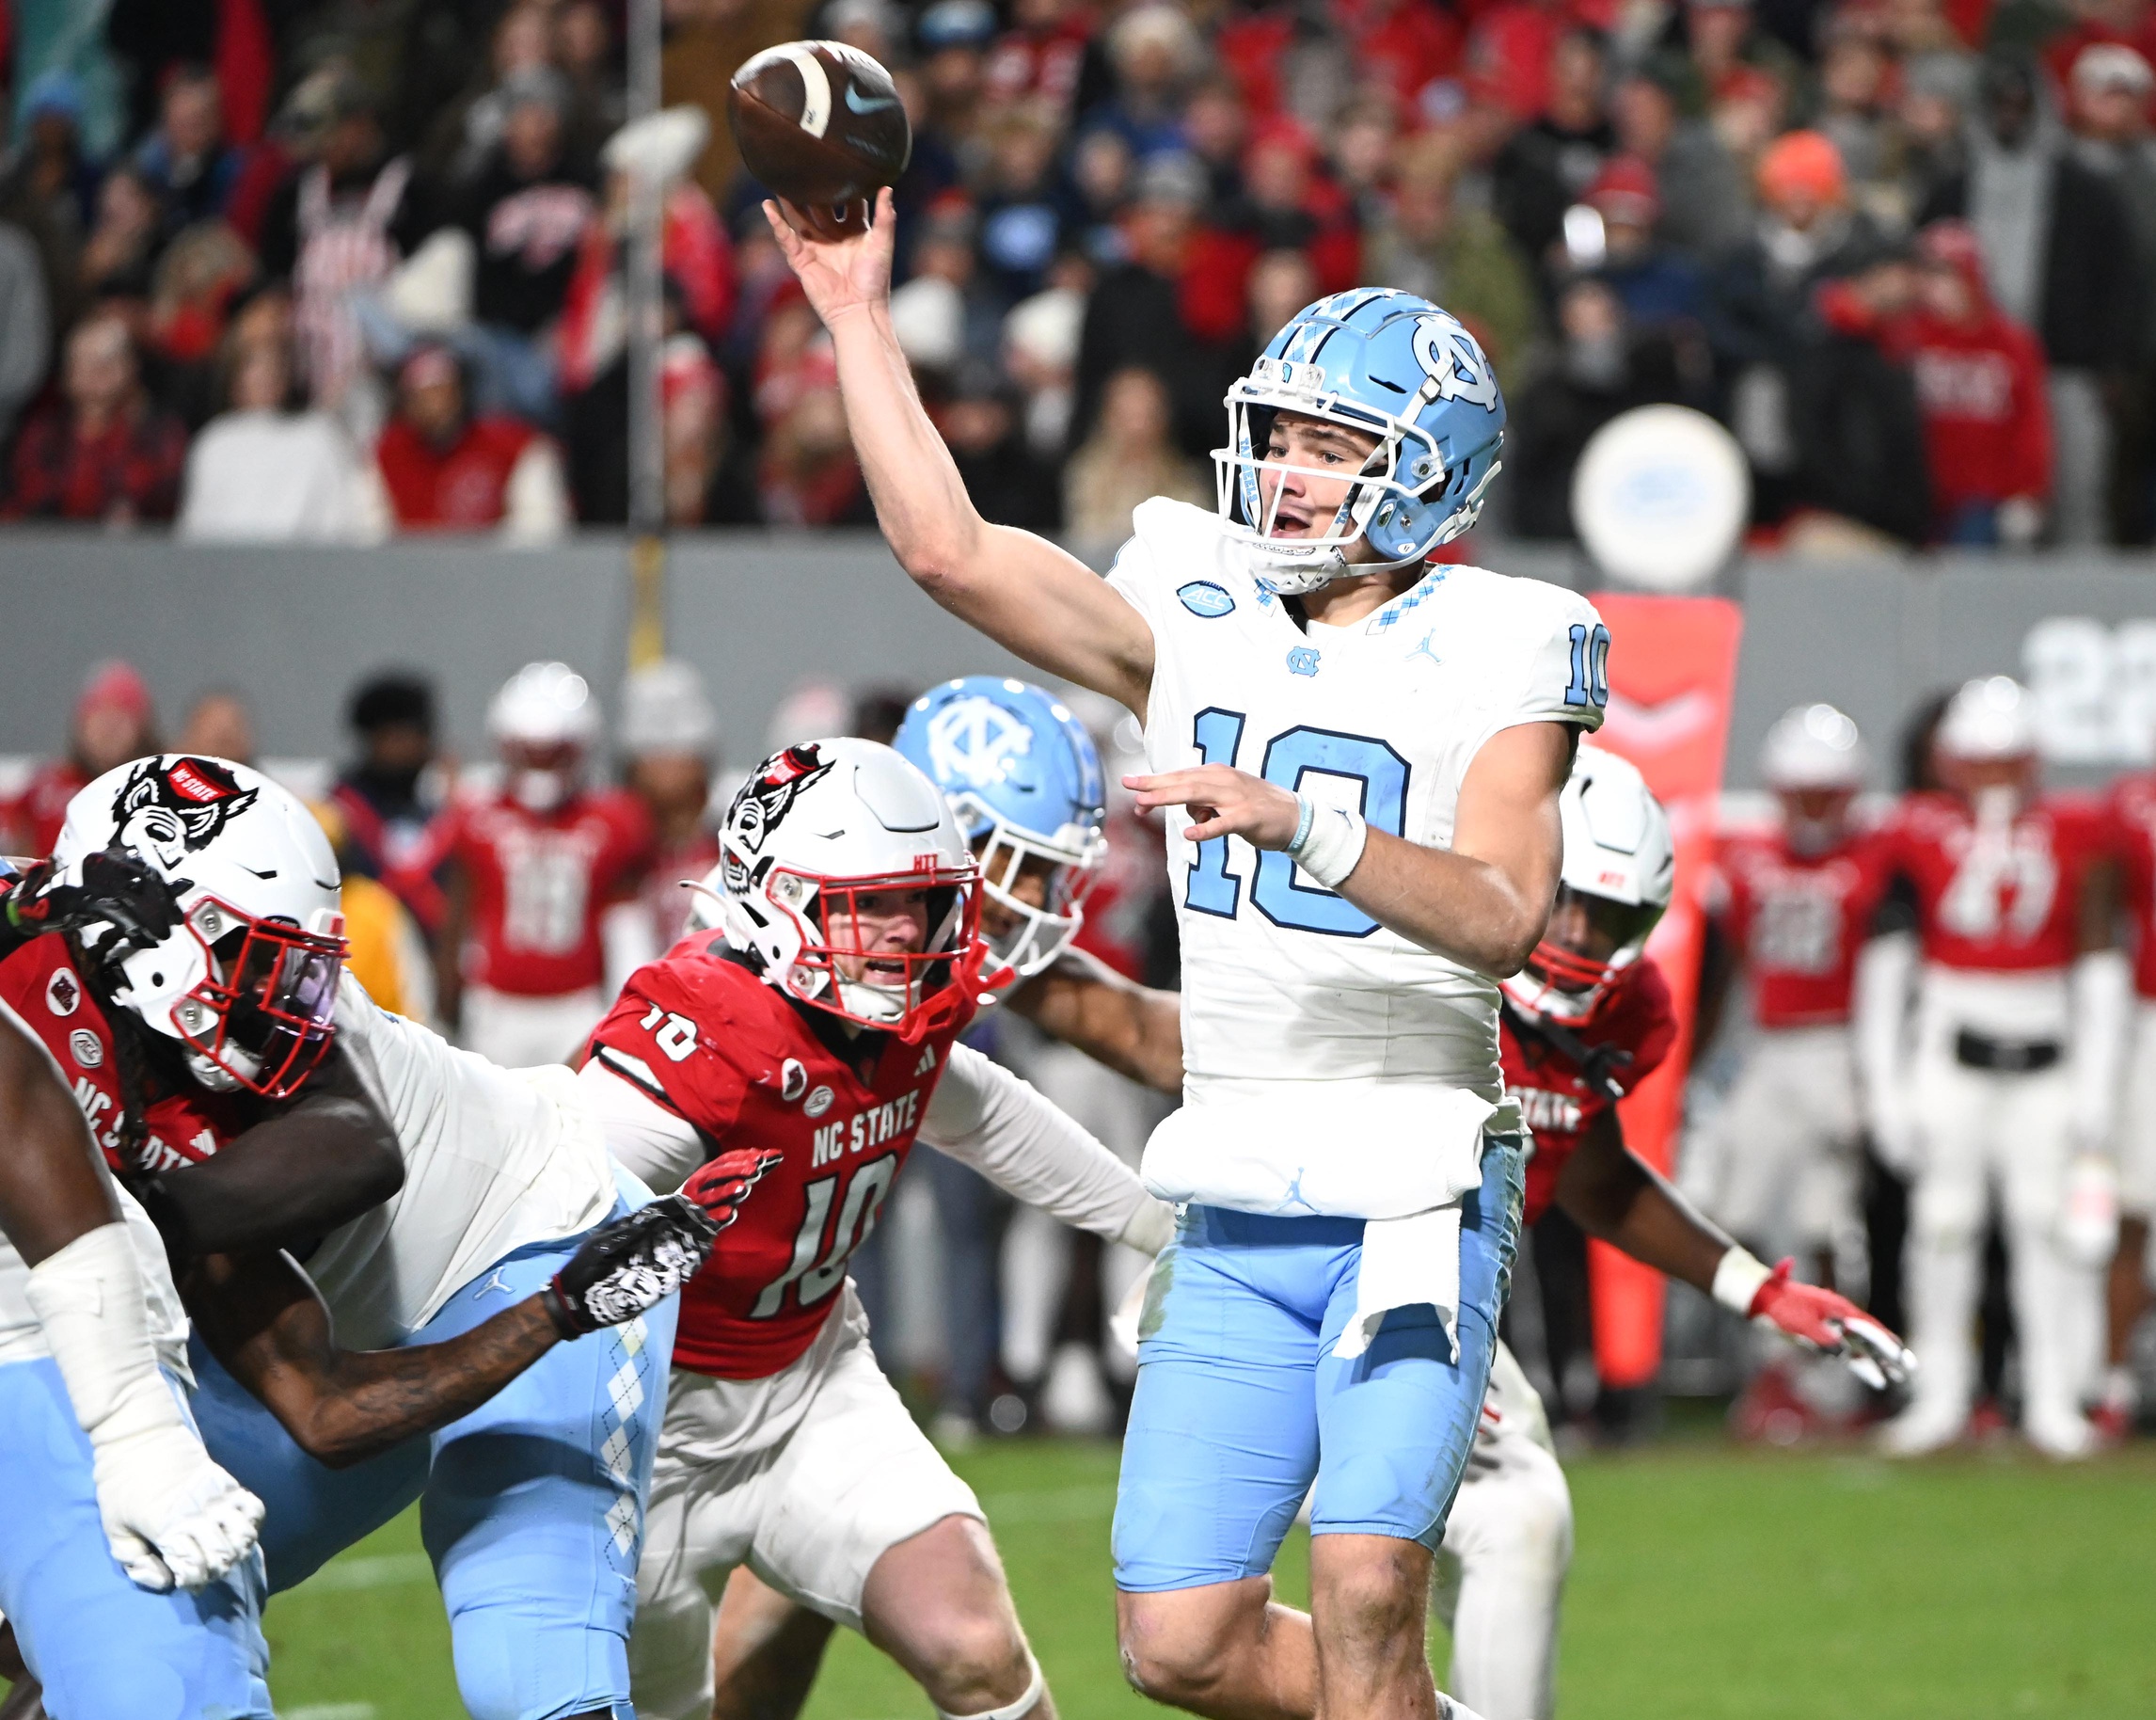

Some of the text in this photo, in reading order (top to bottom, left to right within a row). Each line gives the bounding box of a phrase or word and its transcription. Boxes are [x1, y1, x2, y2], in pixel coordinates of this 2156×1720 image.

[1185, 587, 1227, 608] ACC
[1563, 623, 1611, 709] 10
[170, 768, 219, 802] NC STATE
[1183, 706, 1412, 939] 10
[73, 1075, 113, 1130] NC
[812, 1089, 920, 1169] NC STATE
[749, 1150, 898, 1320] 10
